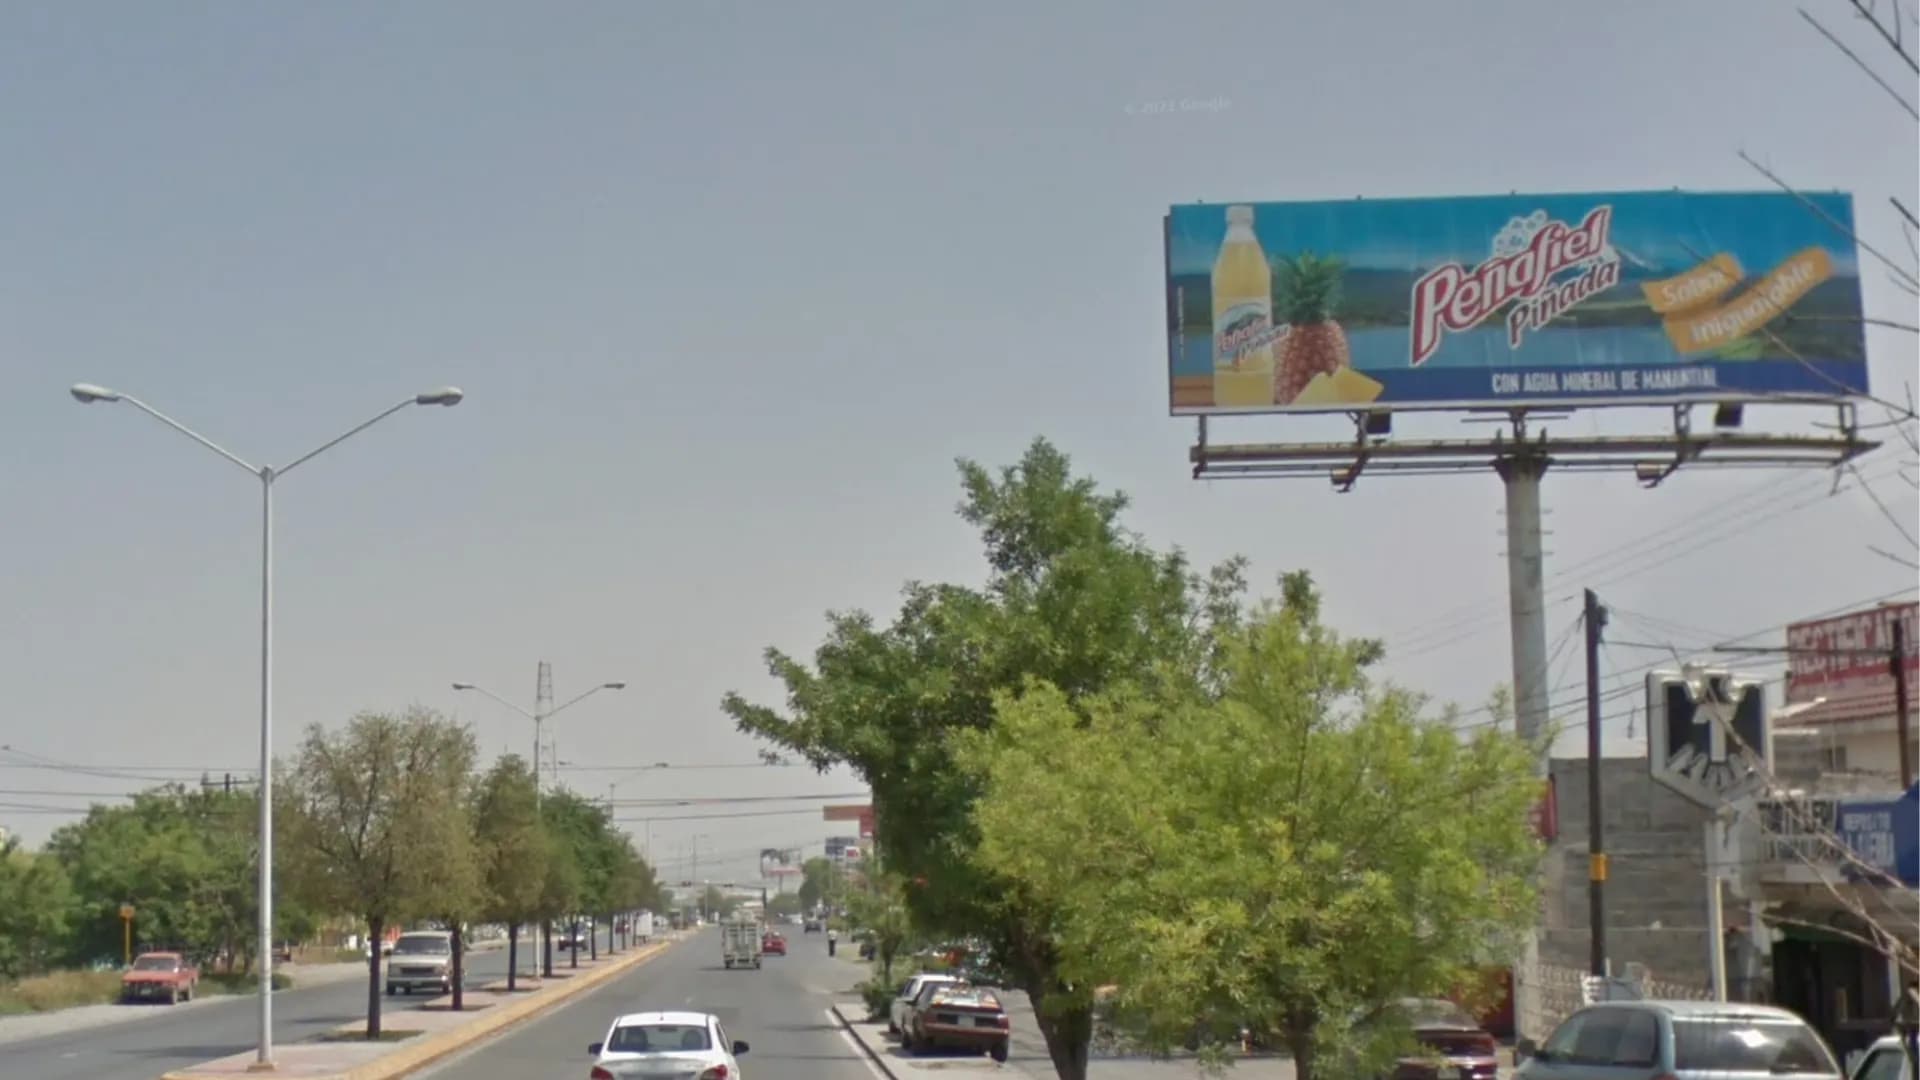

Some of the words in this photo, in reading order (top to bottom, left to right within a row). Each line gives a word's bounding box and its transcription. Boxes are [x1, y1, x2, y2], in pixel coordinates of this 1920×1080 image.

[1411, 205, 1612, 367] Peñafiel
[1509, 254, 1618, 347] Piñada
[1492, 372, 1520, 394] CON
[1523, 372, 1559, 393] AGUA
[1562, 370, 1617, 391] MINERAL
[1621, 369, 1639, 390] DE
[1642, 367, 1718, 389] MANANTIAL
